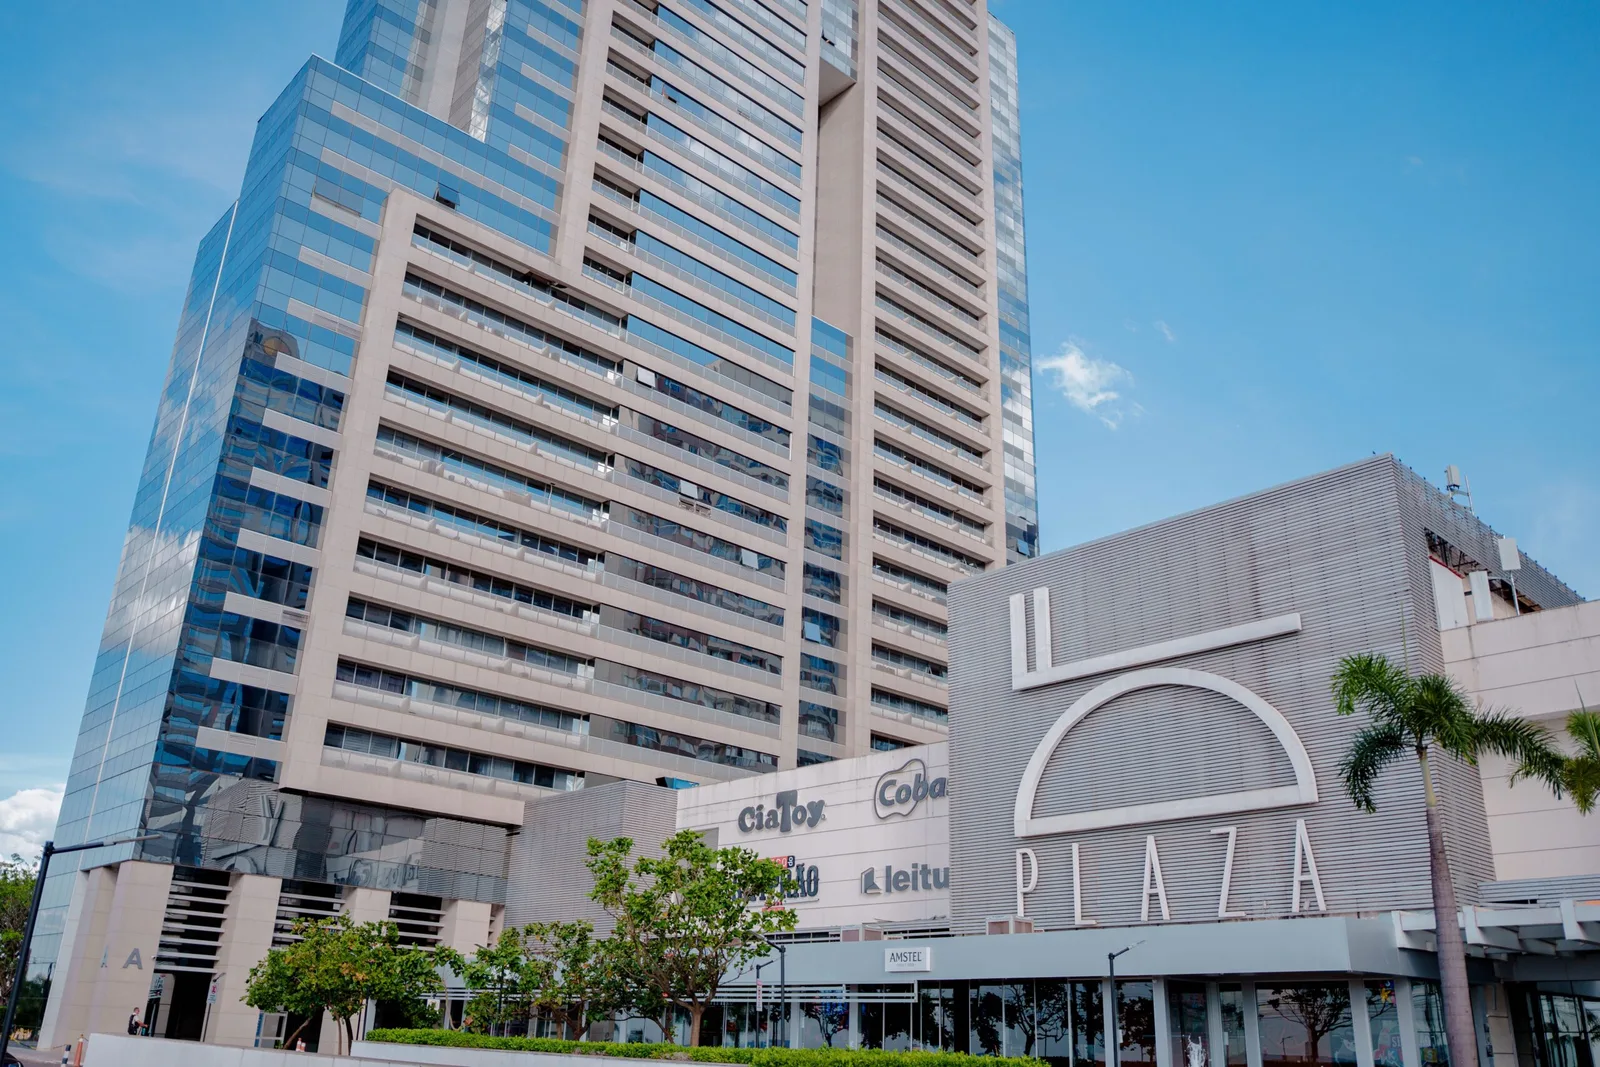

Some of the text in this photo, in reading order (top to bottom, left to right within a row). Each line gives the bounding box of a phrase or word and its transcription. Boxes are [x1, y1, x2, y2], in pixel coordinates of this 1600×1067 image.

[879, 773, 949, 807] Coba
[738, 789, 825, 833] CiaToy
[885, 862, 950, 893] leitu
[1015, 819, 1327, 926] PLAZA
[122, 947, 143, 970] A
[889, 951, 923, 963] AMSTEL
